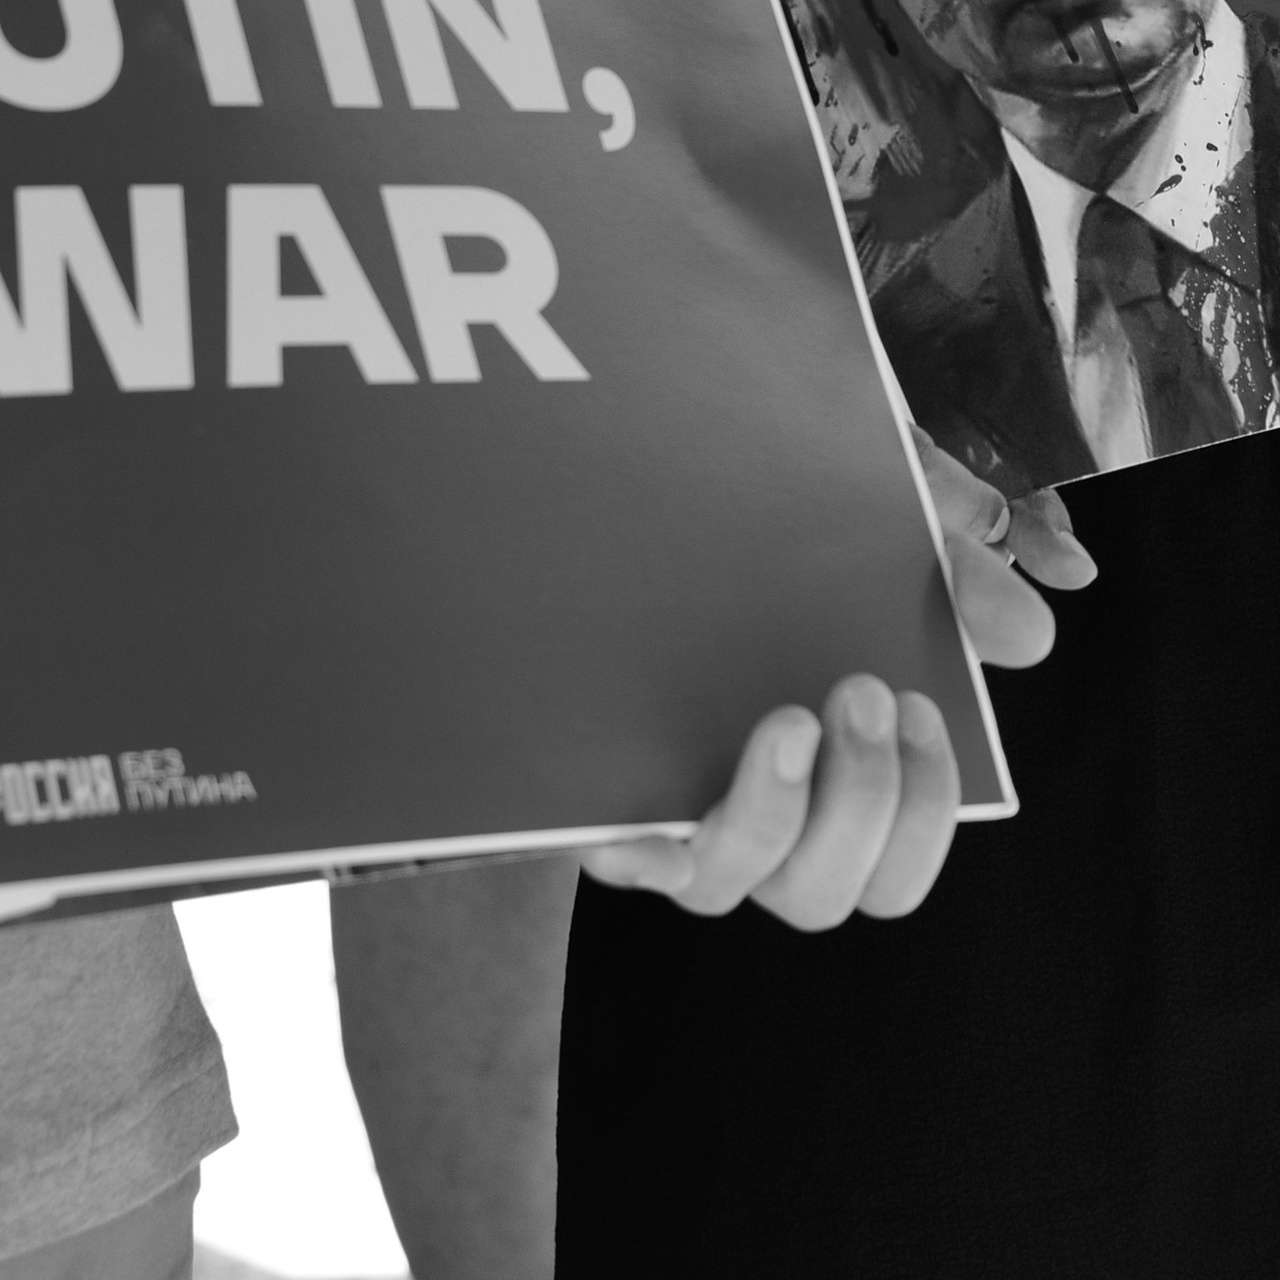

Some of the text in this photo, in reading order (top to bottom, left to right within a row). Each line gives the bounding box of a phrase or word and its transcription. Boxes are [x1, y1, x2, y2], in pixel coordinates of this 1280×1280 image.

[0, 183, 592, 398] WAR
[0, 753, 121, 827] ОССИЯ
[117, 746, 186, 781] БЕЗ
[123, 771, 258, 814] ПУТИНА
